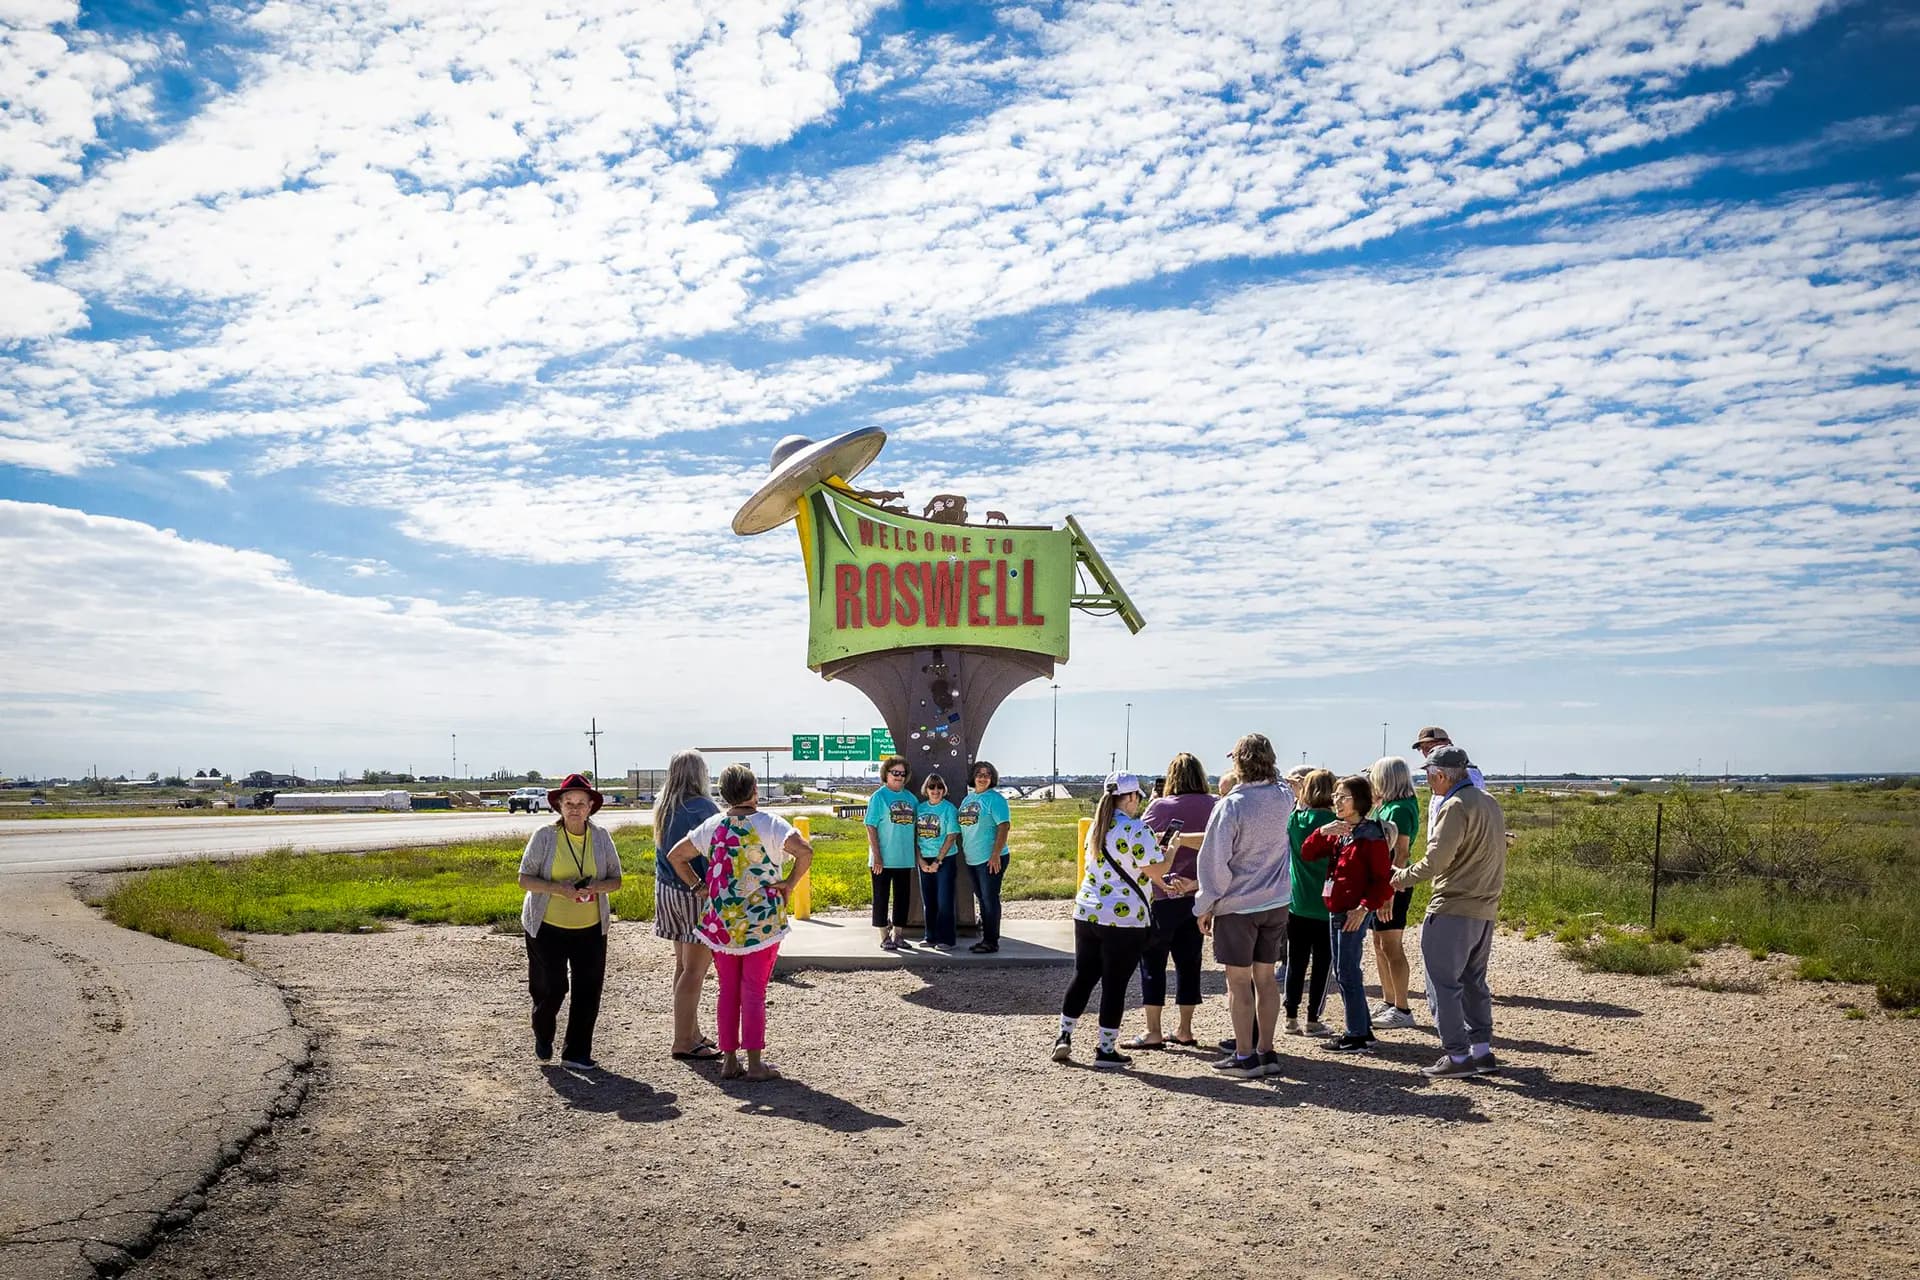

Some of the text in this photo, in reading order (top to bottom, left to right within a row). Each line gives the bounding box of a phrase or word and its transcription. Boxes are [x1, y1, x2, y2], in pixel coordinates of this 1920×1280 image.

[858, 517, 1014, 554] WELCOME TO
[835, 559, 1045, 630] ROSWELL
